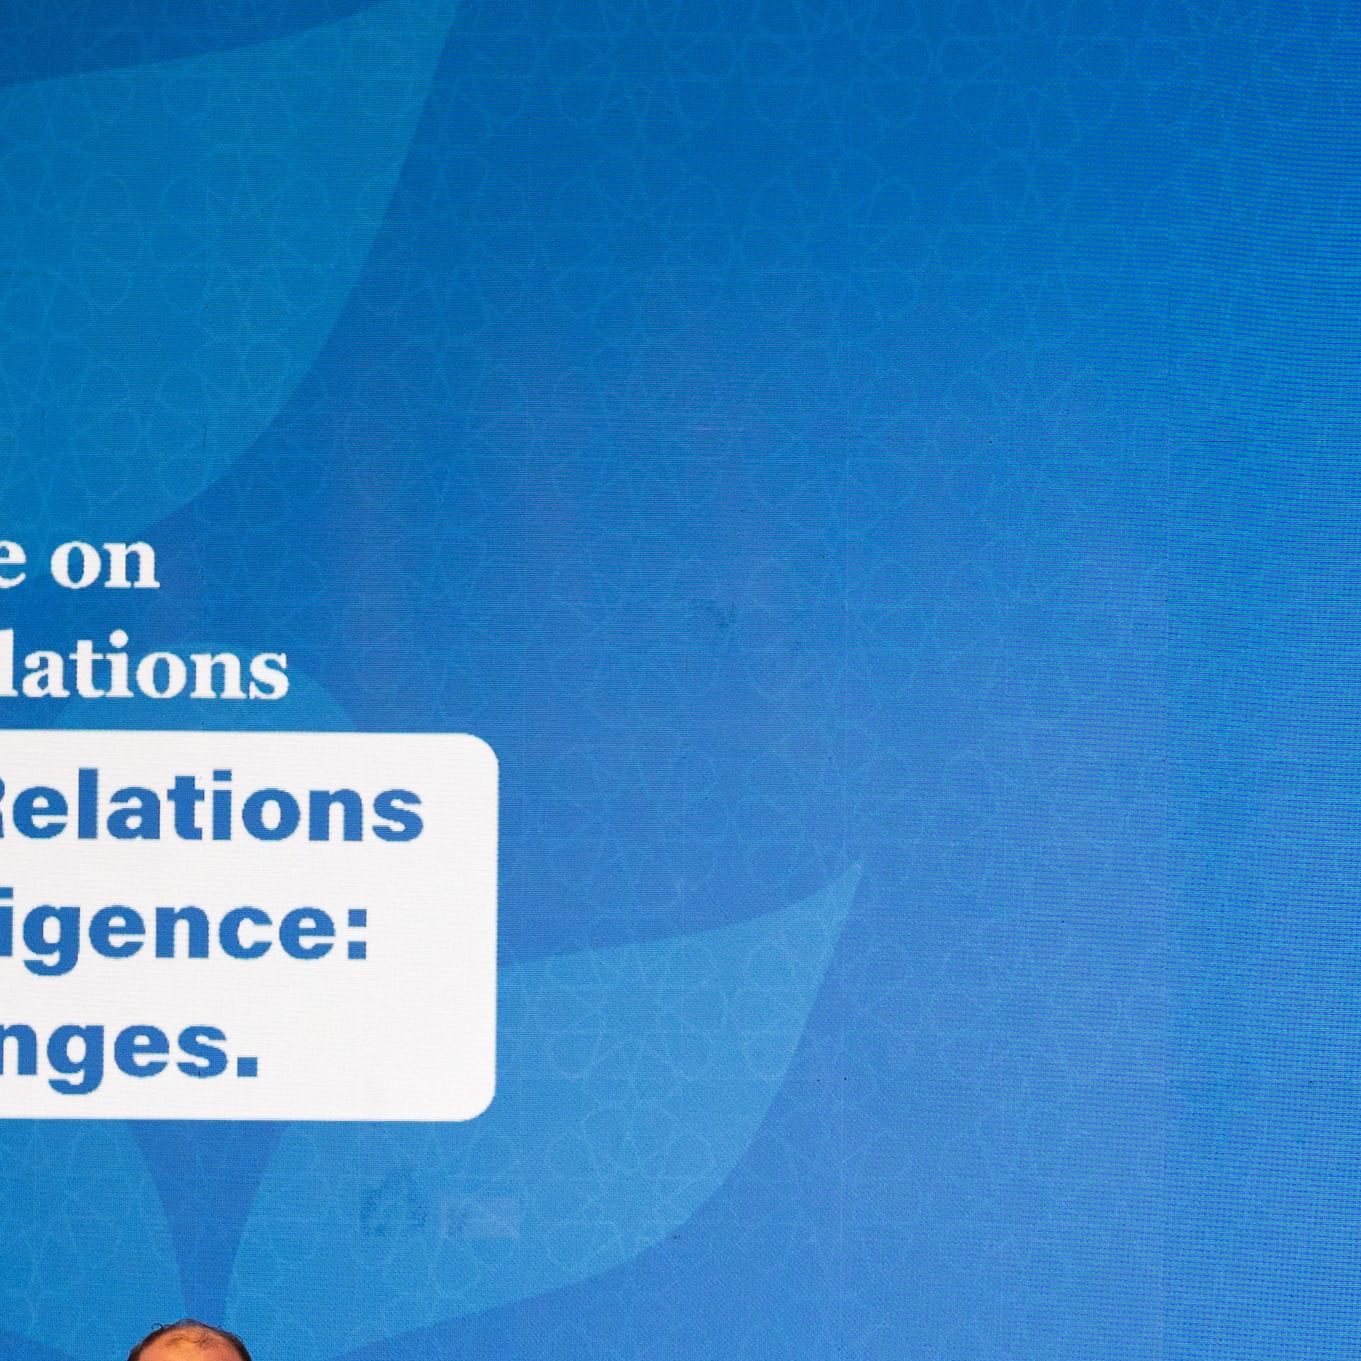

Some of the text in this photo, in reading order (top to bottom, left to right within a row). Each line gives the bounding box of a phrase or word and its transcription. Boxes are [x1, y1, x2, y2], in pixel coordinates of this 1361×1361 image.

[50, 540, 161, 589] on
[0, 766, 425, 843] elations
[0, 886, 368, 977] igence:
[0, 1023, 259, 1095] nges.
